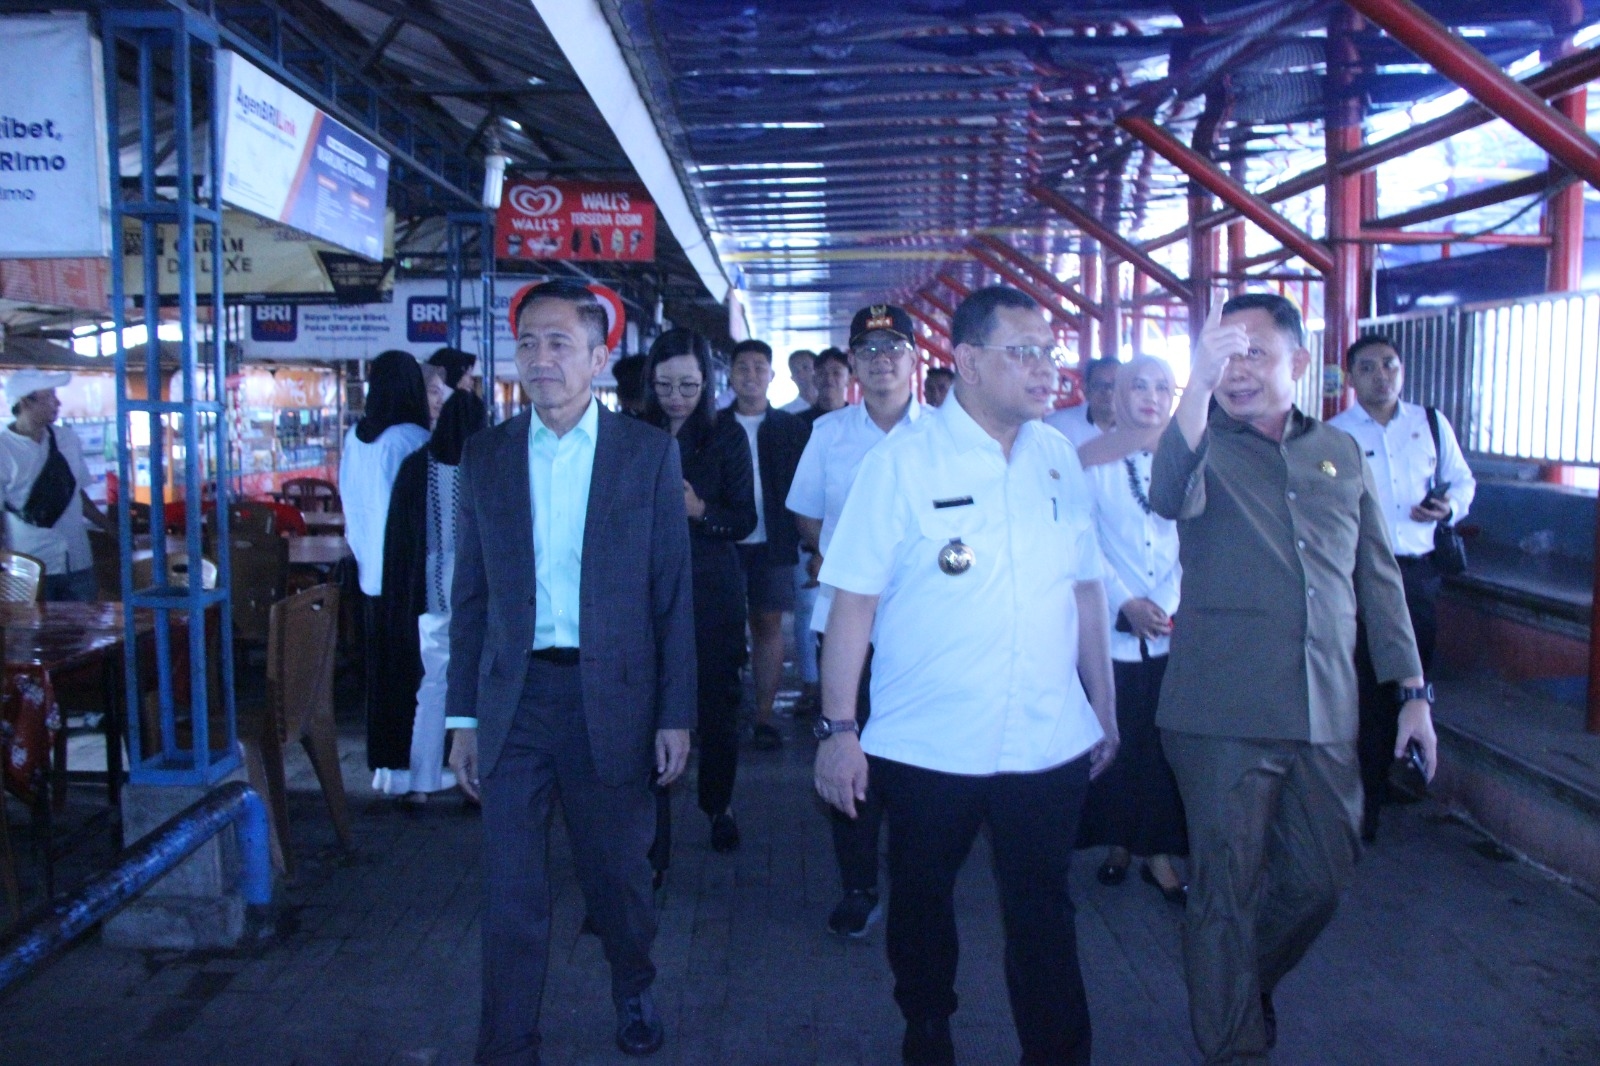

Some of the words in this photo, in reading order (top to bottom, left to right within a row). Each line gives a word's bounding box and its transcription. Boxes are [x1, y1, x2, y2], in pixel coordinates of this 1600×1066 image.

[0, 116, 63, 141] ibet,
[581, 192, 631, 212] WALL'S
[511, 217, 560, 232] WALL'S
[166, 254, 253, 275] DLXE
[256, 304, 291, 321] BRI
[411, 303, 447, 322] BRI
